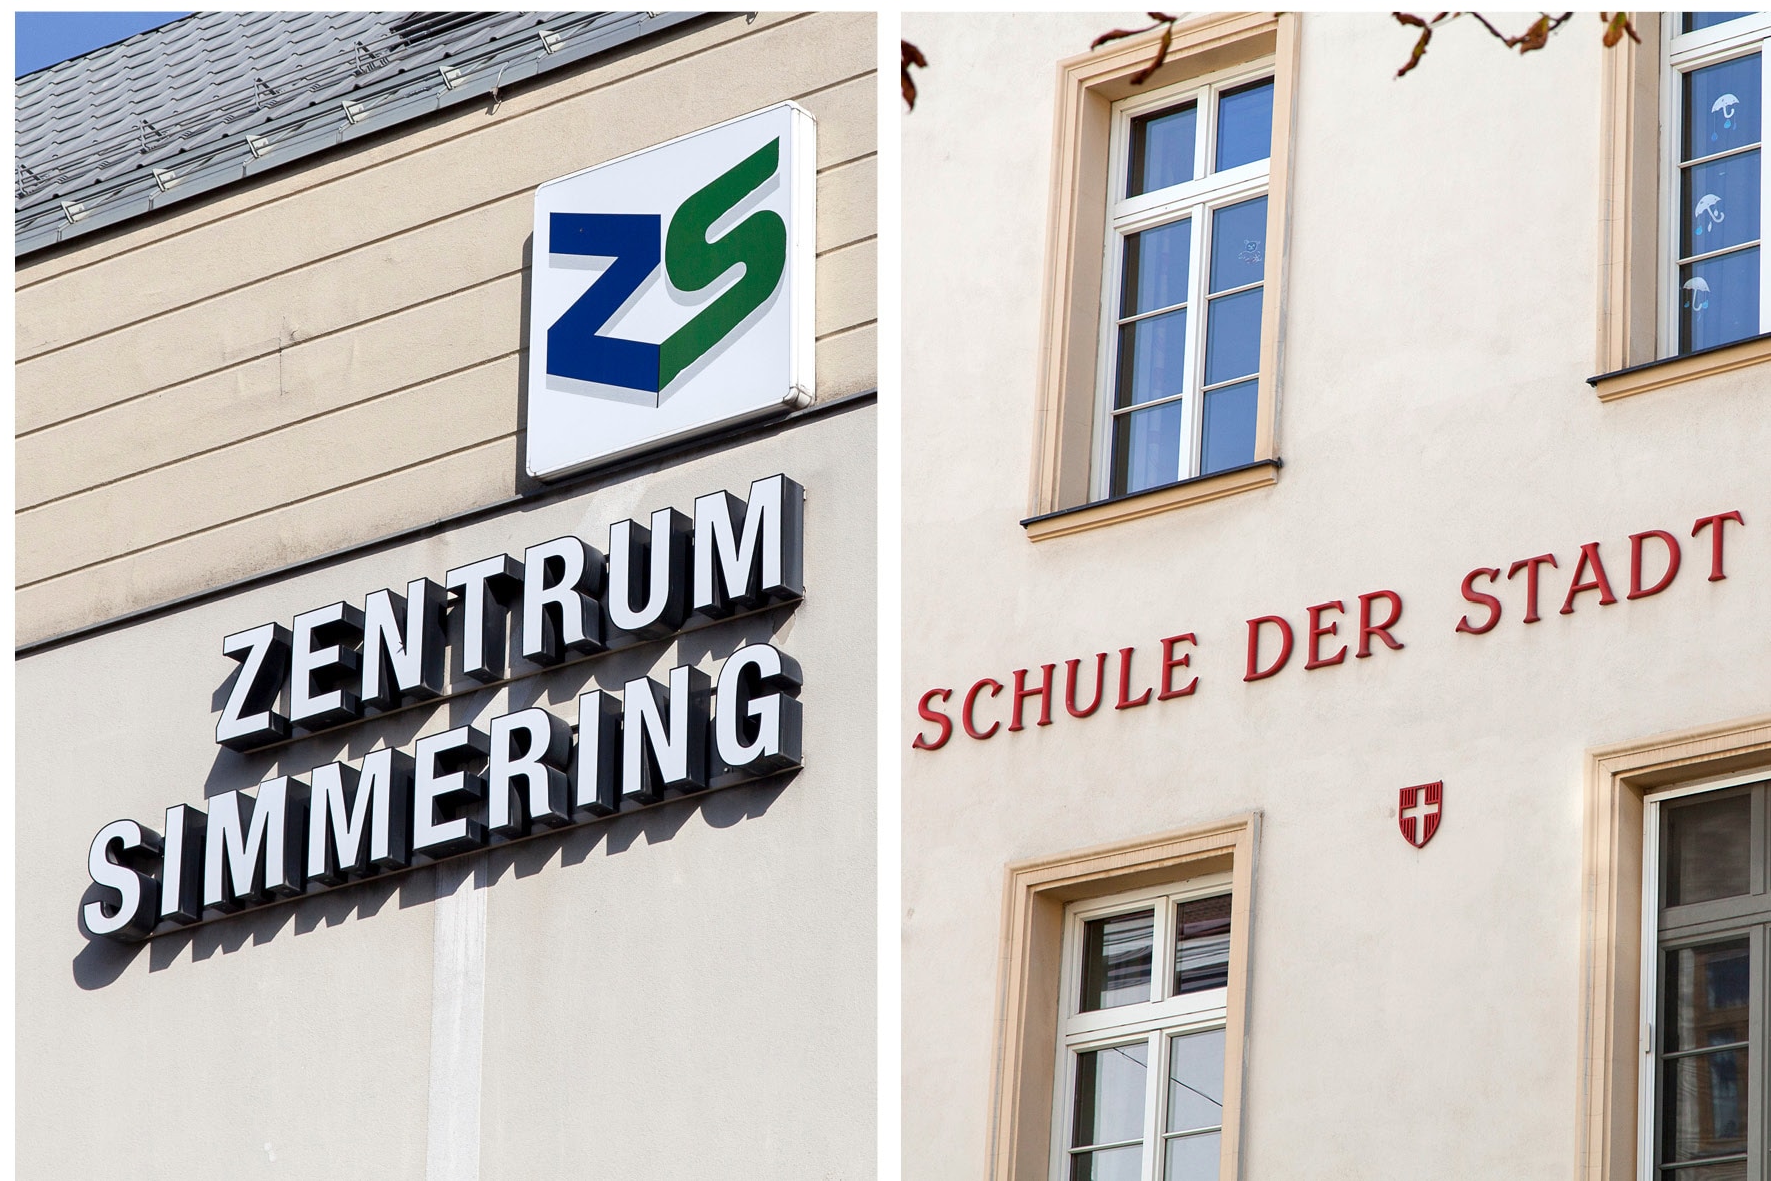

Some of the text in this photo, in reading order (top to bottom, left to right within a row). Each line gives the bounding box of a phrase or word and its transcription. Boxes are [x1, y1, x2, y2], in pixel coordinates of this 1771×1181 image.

[546, 136, 788, 393] ZS
[216, 474, 788, 745] ZENTRUM
[912, 510, 1746, 751] SCHULE DER STADT
[83, 643, 788, 938] SIMMERING
